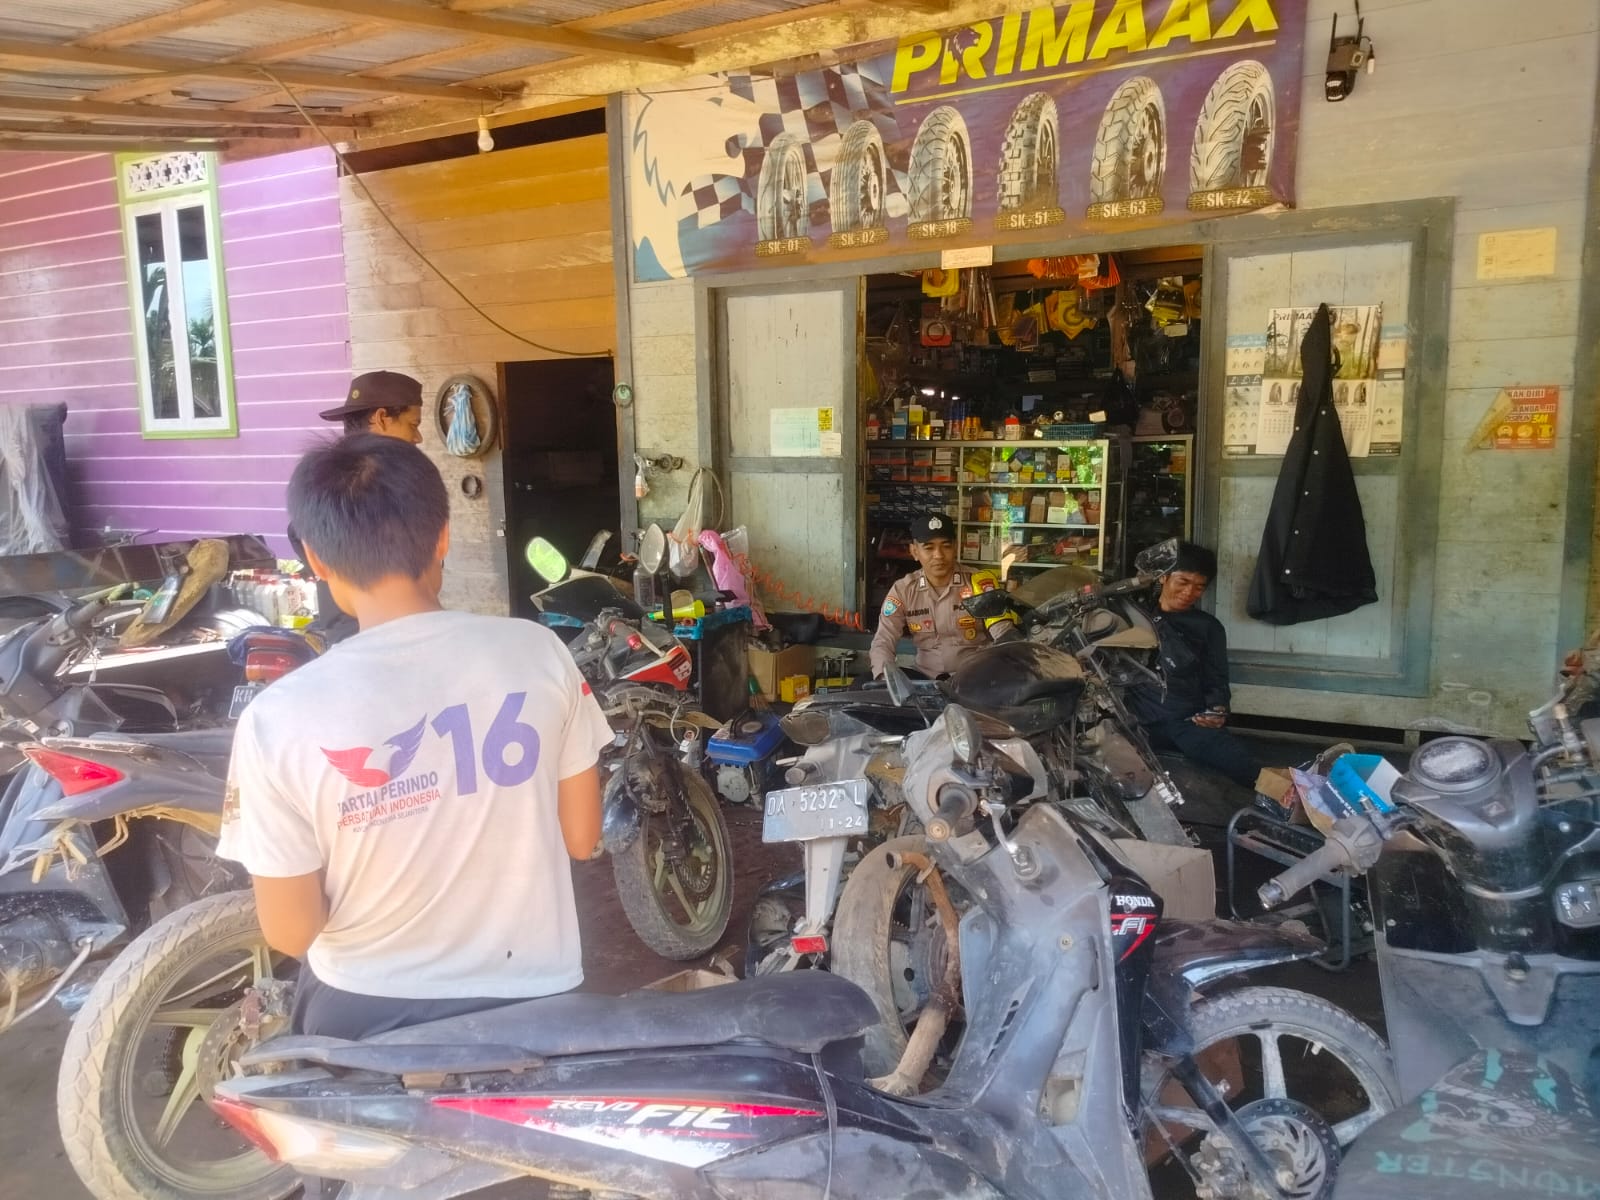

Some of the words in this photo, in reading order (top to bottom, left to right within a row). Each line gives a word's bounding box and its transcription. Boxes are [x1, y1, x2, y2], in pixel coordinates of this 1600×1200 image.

[890, 0, 1279, 94] PRIMAAX
[431, 691, 541, 797] 16
[380, 770, 438, 801] PERINDO
[389, 788, 441, 812] INDONESIA
[766, 794, 786, 817] DA
[799, 788, 838, 813] 5232
[854, 784, 862, 806] L
[1114, 895, 1156, 907] HONDA
